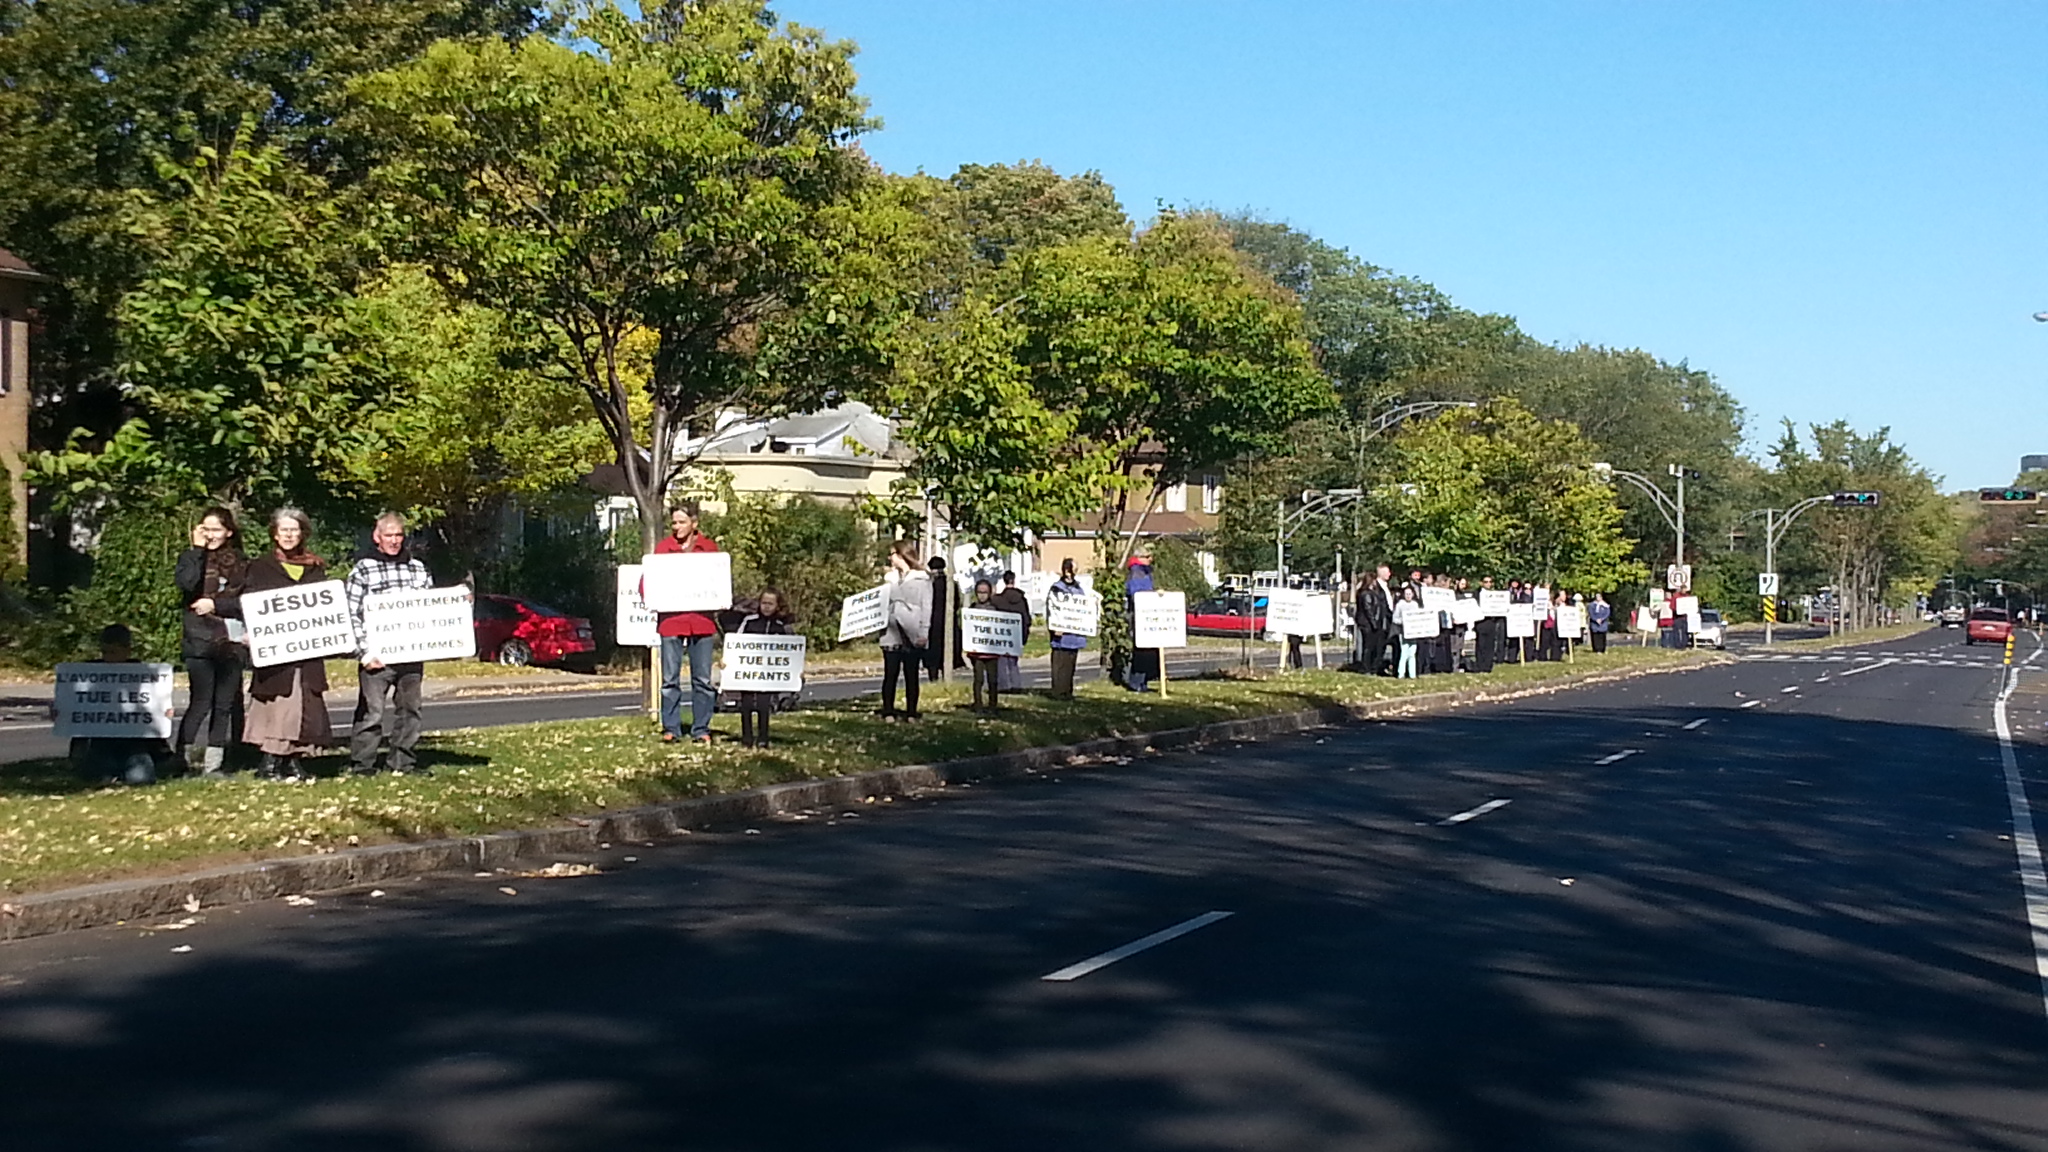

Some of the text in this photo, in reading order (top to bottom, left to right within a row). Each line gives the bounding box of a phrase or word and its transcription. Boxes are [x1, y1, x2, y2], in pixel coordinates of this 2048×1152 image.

[257, 589, 334, 615] JÉSUS
[366, 594, 466, 612] L'AVORTEMENT
[253, 613, 346, 638] PARDONNE
[376, 617, 463, 633] FAIT DU TORT
[974, 625, 1012, 636] TUE LES
[258, 633, 349, 658] ET GUERIT
[380, 639, 464, 654] AUX FEMMES
[726, 642, 804, 652] L'AVORTEMENT
[972, 636, 1014, 648] ENFANTS
[738, 656, 790, 666] TUE LES
[56, 673, 169, 683] L'AVORTEMENT
[734, 670, 791, 681] ENFANTS
[76, 691, 150, 704] TUE LES
[72, 711, 153, 724] ENFANTS
